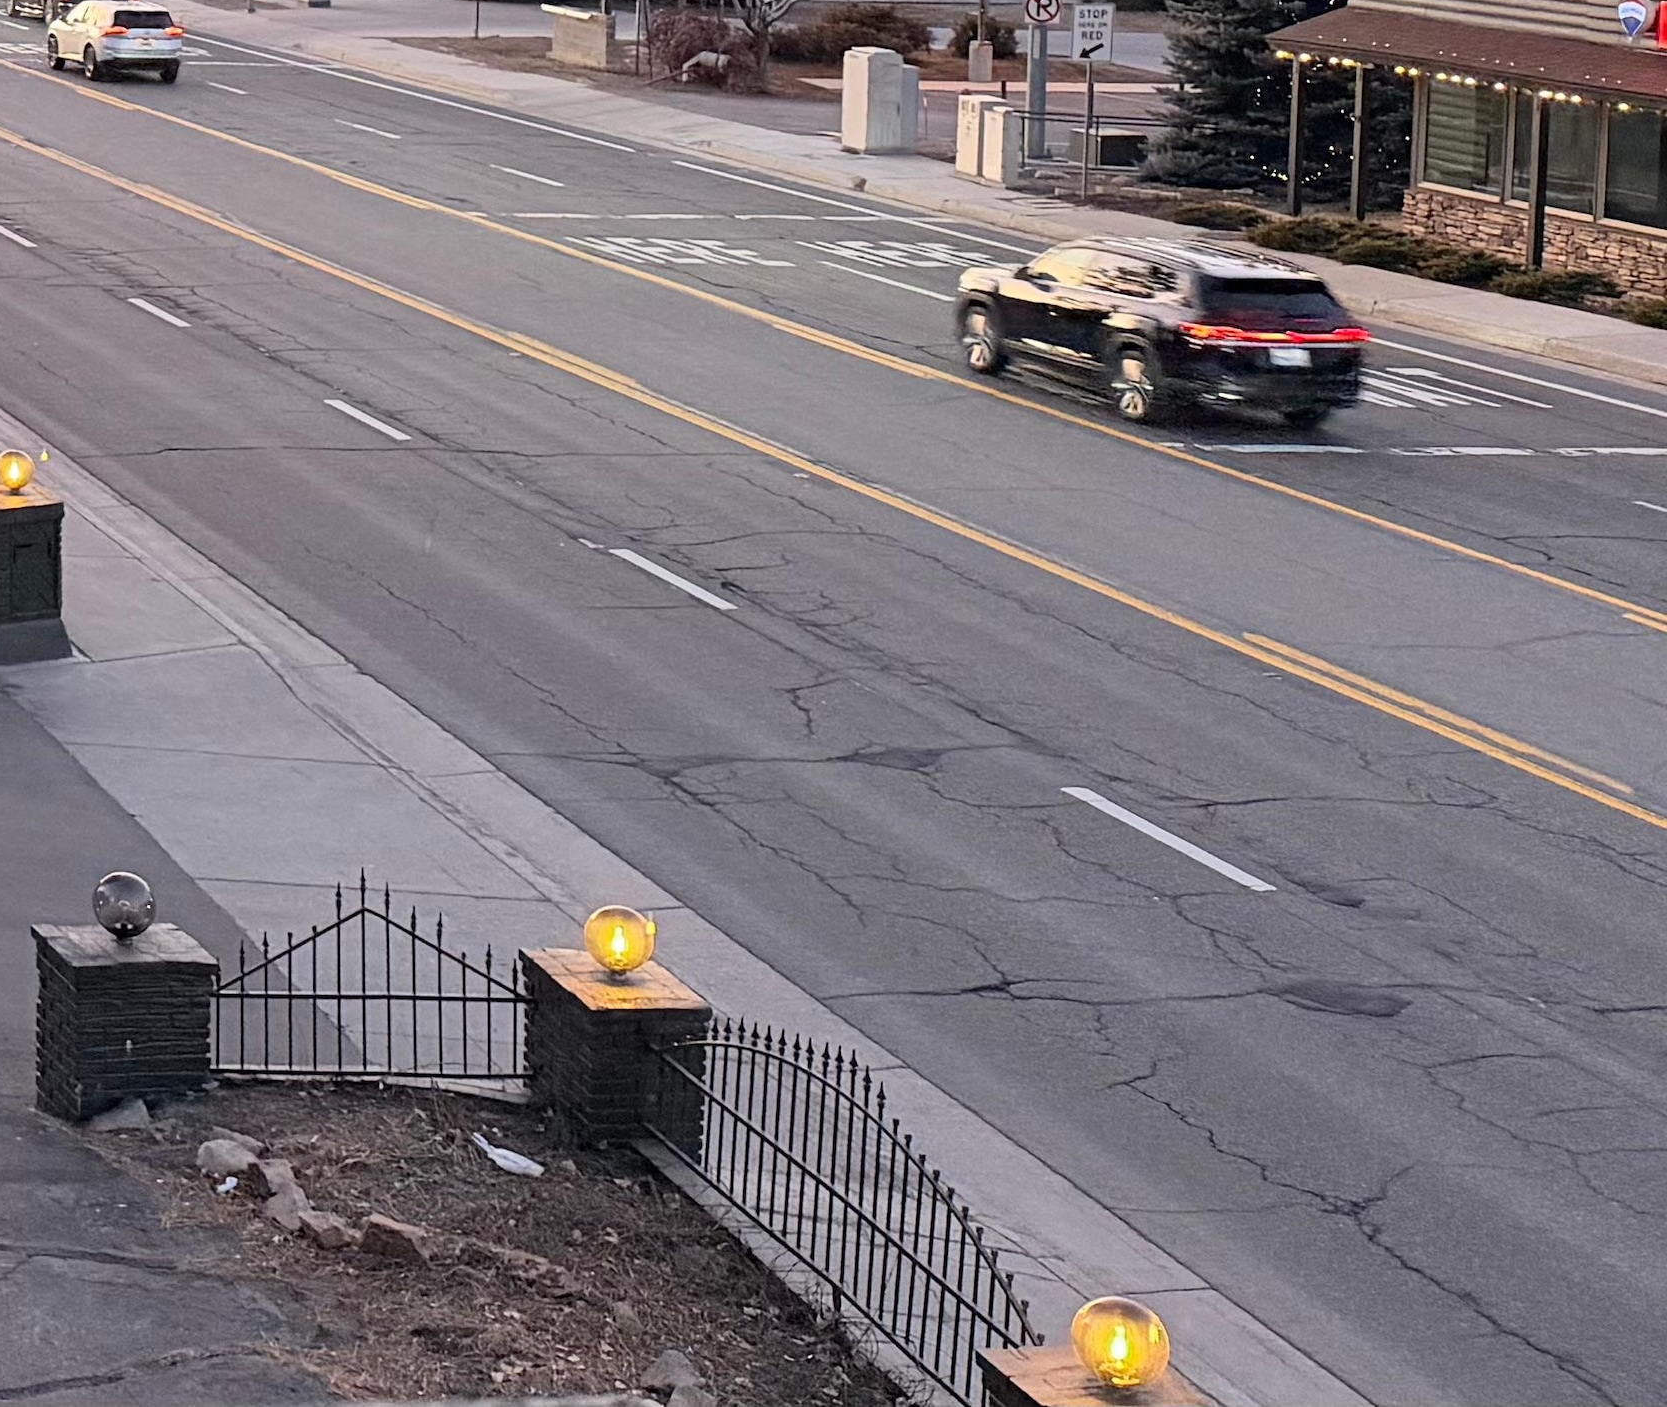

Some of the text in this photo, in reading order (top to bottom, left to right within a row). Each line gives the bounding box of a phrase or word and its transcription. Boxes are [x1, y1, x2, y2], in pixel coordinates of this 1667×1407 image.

[1079, 9, 1108, 19] STOP
[1081, 31, 1103, 40] RED
[564, 236, 796, 267] HERE
